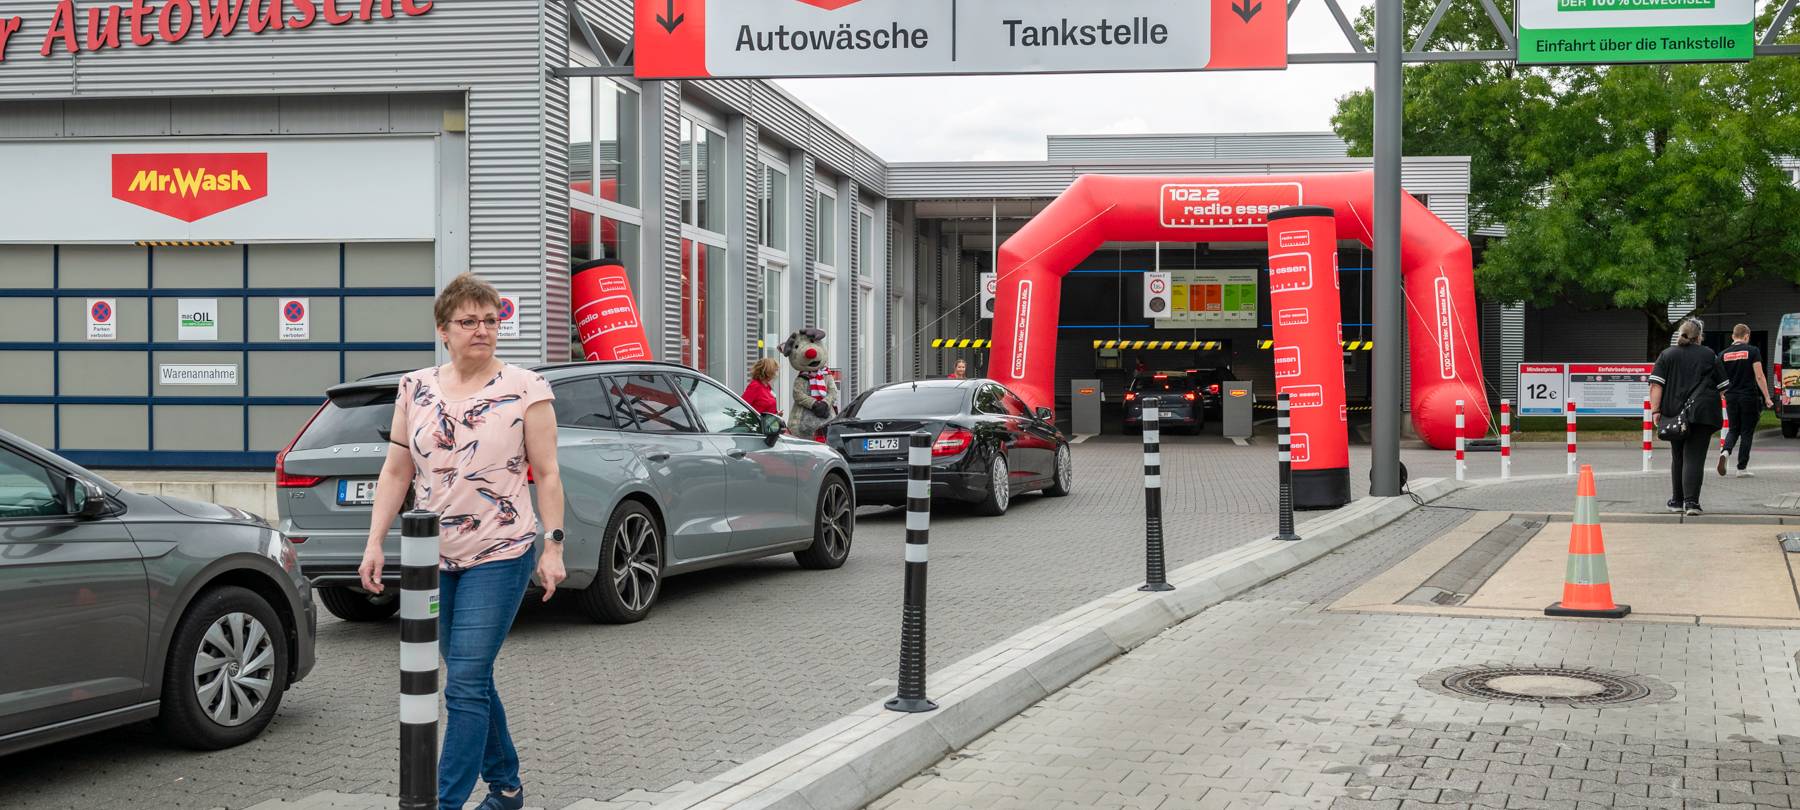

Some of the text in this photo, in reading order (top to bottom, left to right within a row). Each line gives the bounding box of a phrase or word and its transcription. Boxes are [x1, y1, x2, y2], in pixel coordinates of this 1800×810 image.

[735, 22, 929, 52] Autowäsche
[1002, 16, 1168, 47] Tankstelle
[1536, 36, 1735, 52] Einfahrt über die Tankstelle
[1169, 188, 1220, 202] 102.2
[1183, 203, 1232, 215] radio
[1275, 265, 1307, 275] essen
[579, 306, 631, 327] radio essen
[162, 368, 235, 379] Warenannahme
